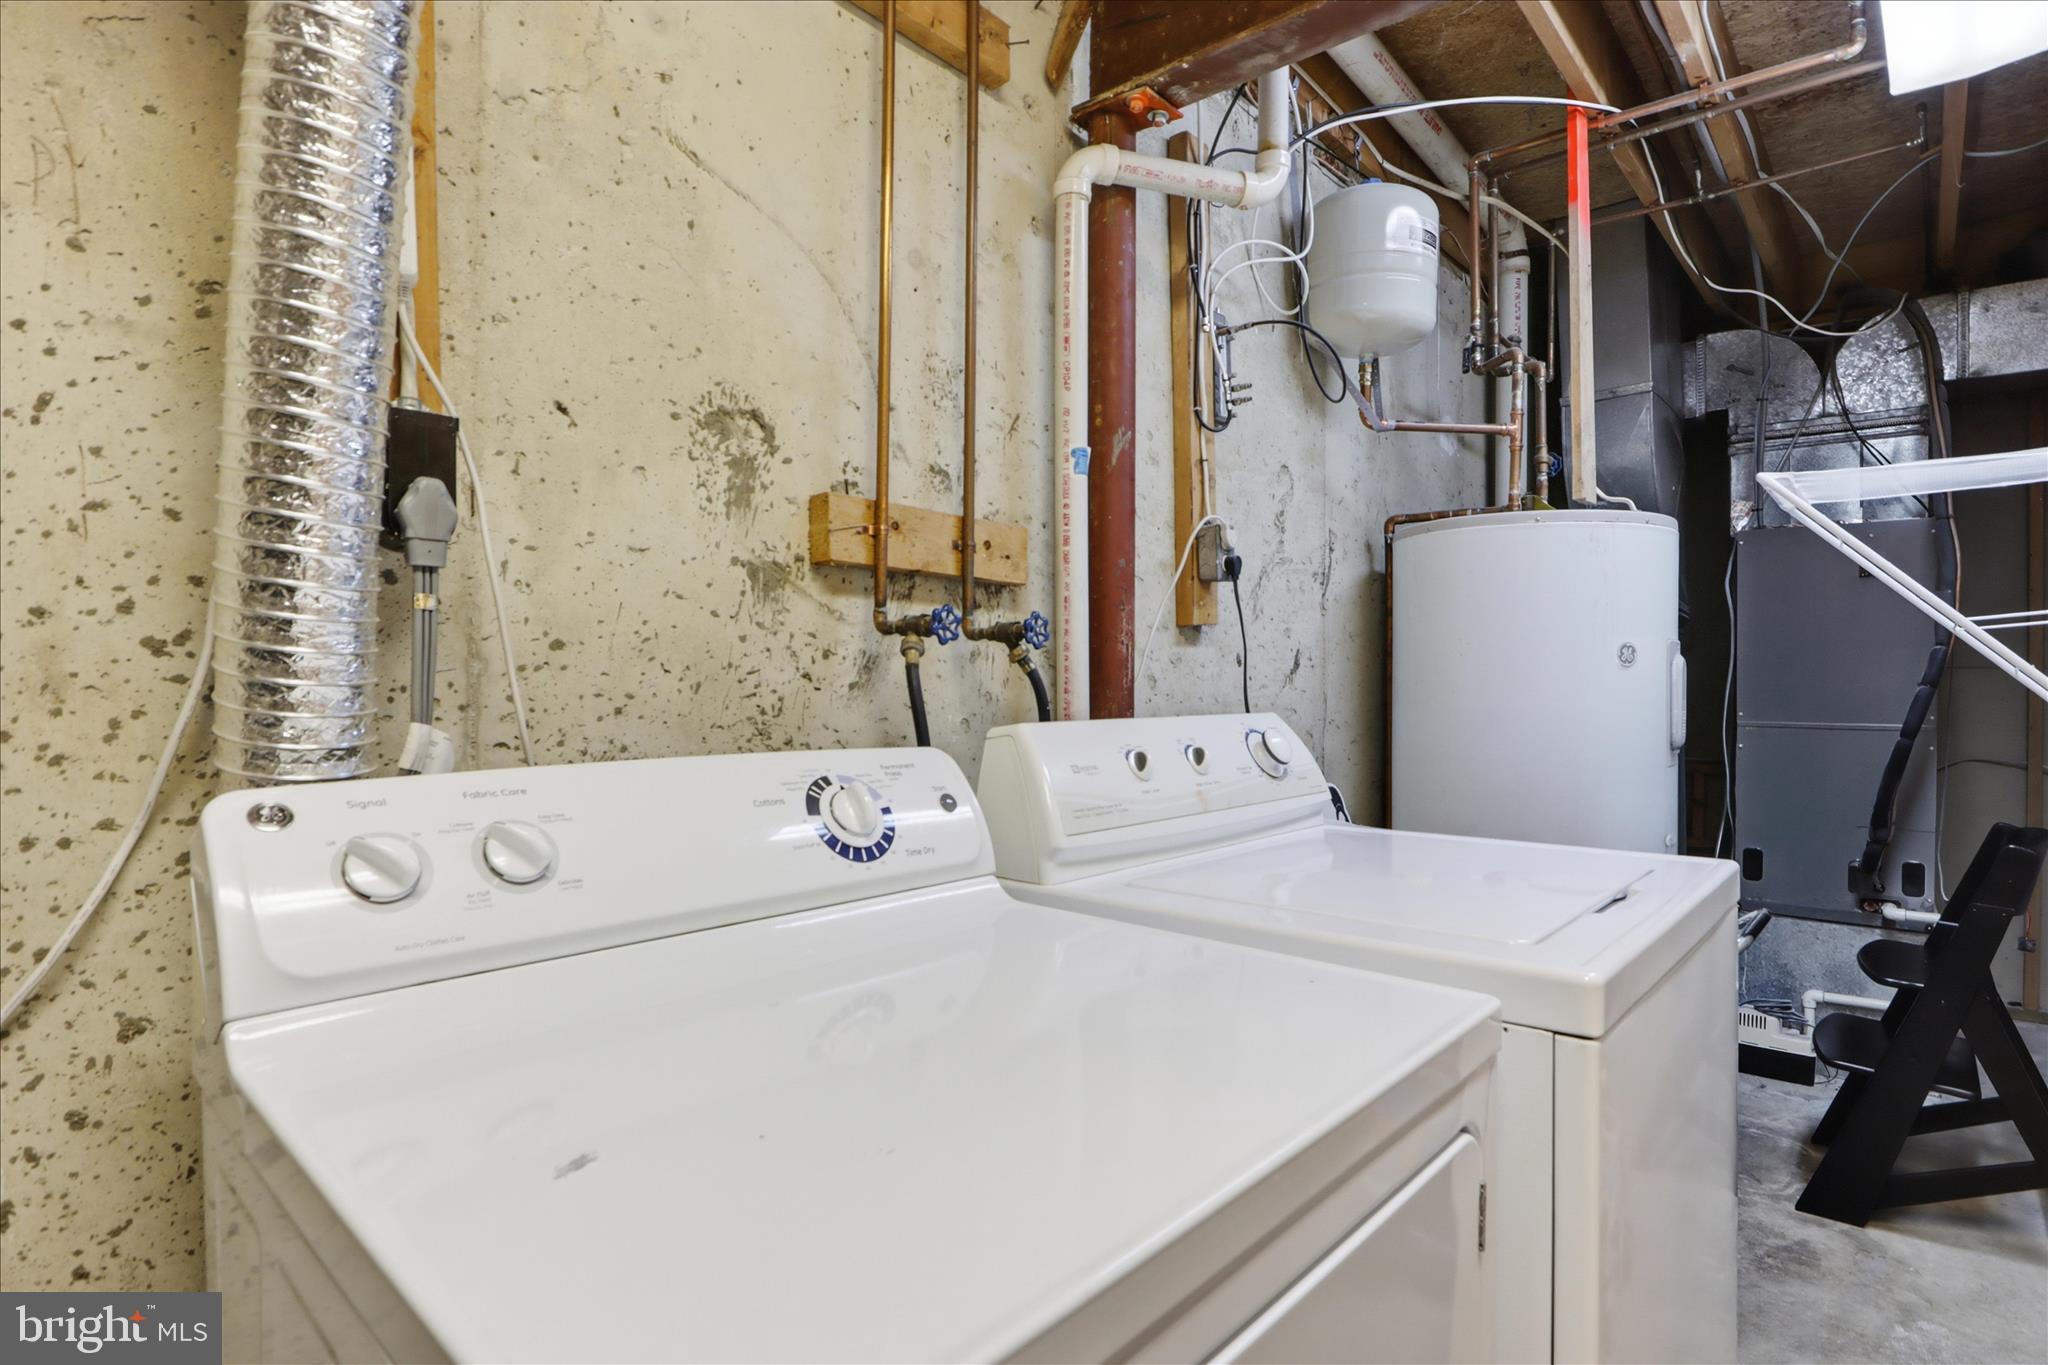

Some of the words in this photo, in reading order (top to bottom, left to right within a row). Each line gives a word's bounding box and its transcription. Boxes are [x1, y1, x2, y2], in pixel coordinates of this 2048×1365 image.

[462, 788, 498, 801] Fabric
[500, 786, 528, 798] Care
[345, 797, 387, 811] Signal
[752, 798, 786, 809] Cottons
[904, 848, 922, 858] Time
[923, 846, 936, 857] Dry
